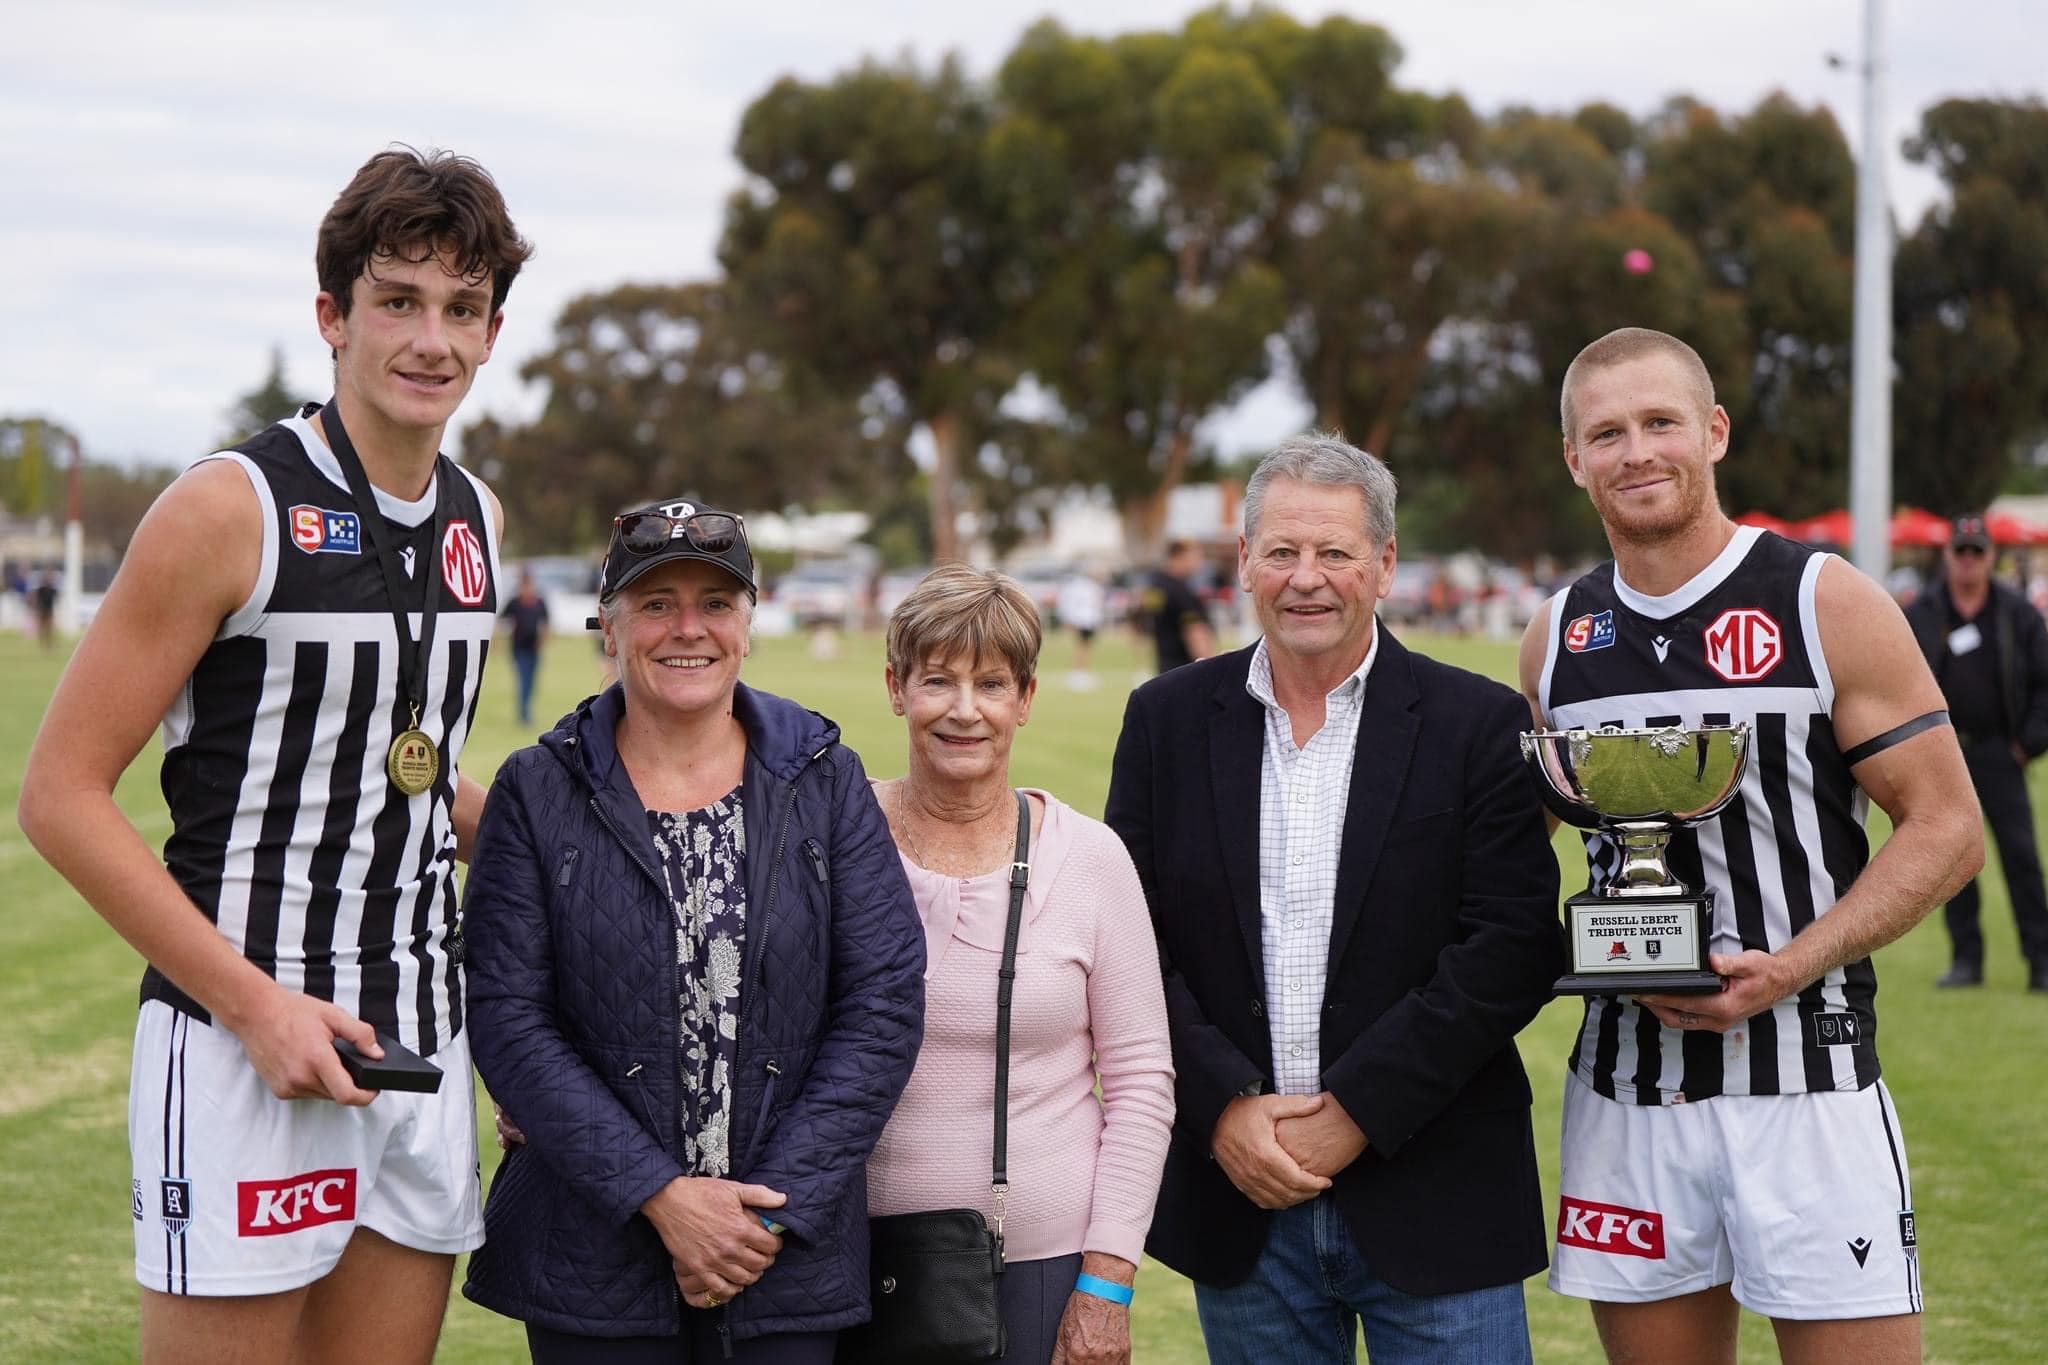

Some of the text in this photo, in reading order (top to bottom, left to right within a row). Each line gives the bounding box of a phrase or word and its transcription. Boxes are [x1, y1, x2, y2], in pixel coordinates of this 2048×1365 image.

[445, 528, 485, 598] MG
[1709, 614, 1777, 675] MG
[1587, 926, 1683, 937] TRIBUTE MATCH
[1590, 915, 1679, 926] RUSSELL EBERT
[250, 1177, 346, 1228] KFC
[1561, 1206, 1654, 1250] KFC
